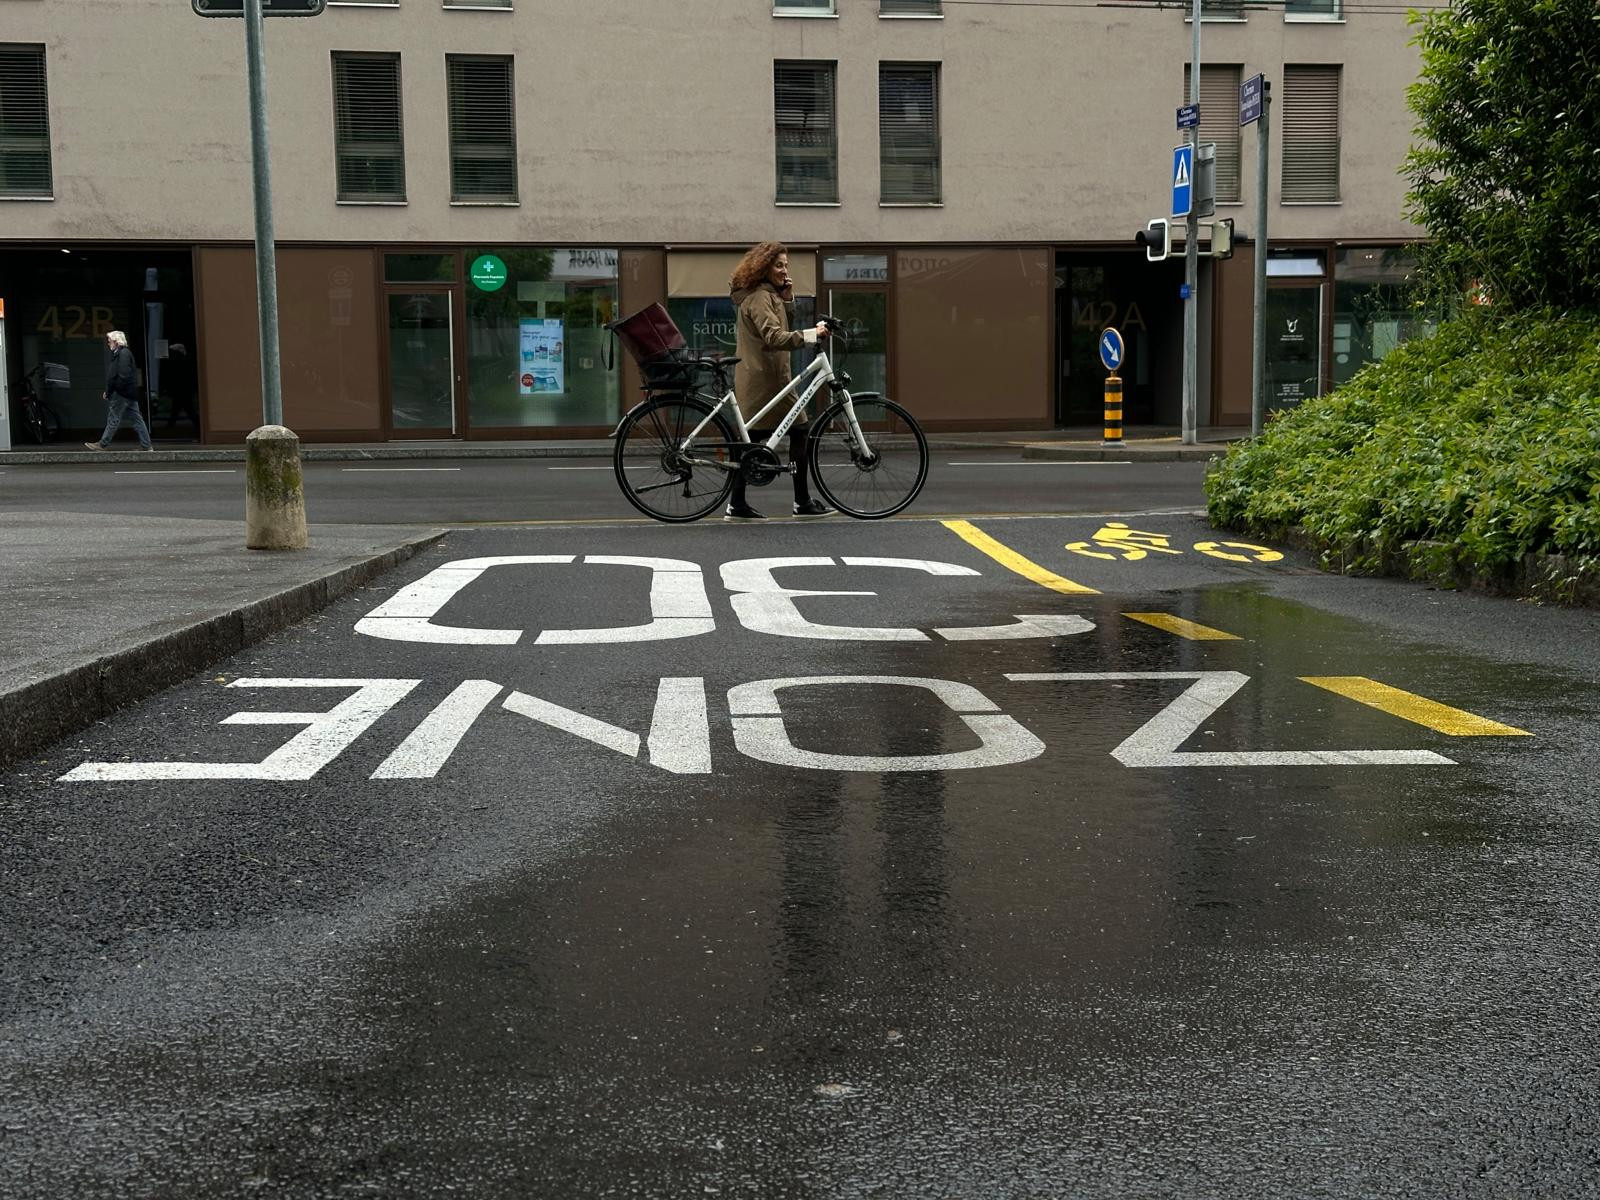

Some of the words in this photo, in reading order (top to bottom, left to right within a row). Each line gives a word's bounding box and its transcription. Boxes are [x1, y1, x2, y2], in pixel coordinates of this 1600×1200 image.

[36, 304, 114, 339] 42B
[1076, 301, 1148, 332] 42A
[57, 671, 1457, 782] ZONE
